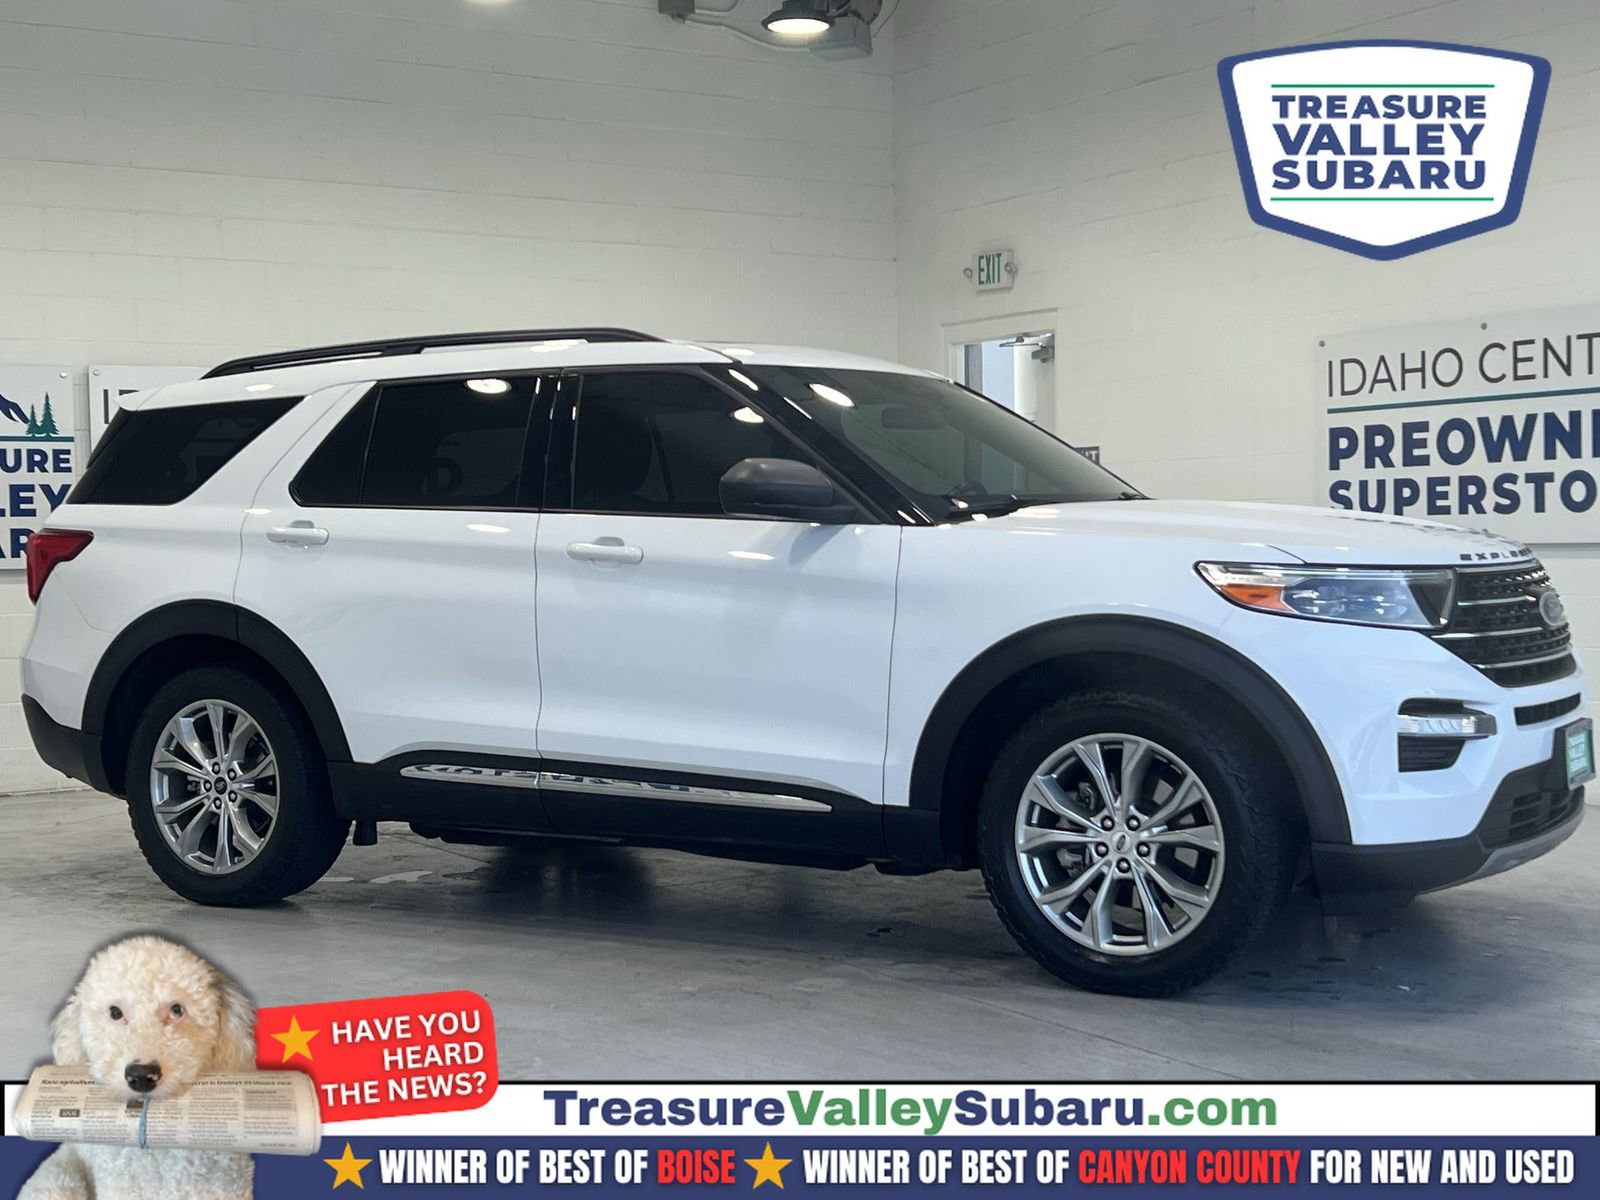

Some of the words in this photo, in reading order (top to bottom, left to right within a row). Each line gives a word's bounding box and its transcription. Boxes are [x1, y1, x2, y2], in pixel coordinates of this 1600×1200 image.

[977, 252, 1003, 285] EXIT
[1327, 347, 1464, 398] IDAHO
[1478, 332, 1600, 384] CENT
[0, 483, 72, 518] EY
[1328, 469, 1598, 517] SUPERSTO
